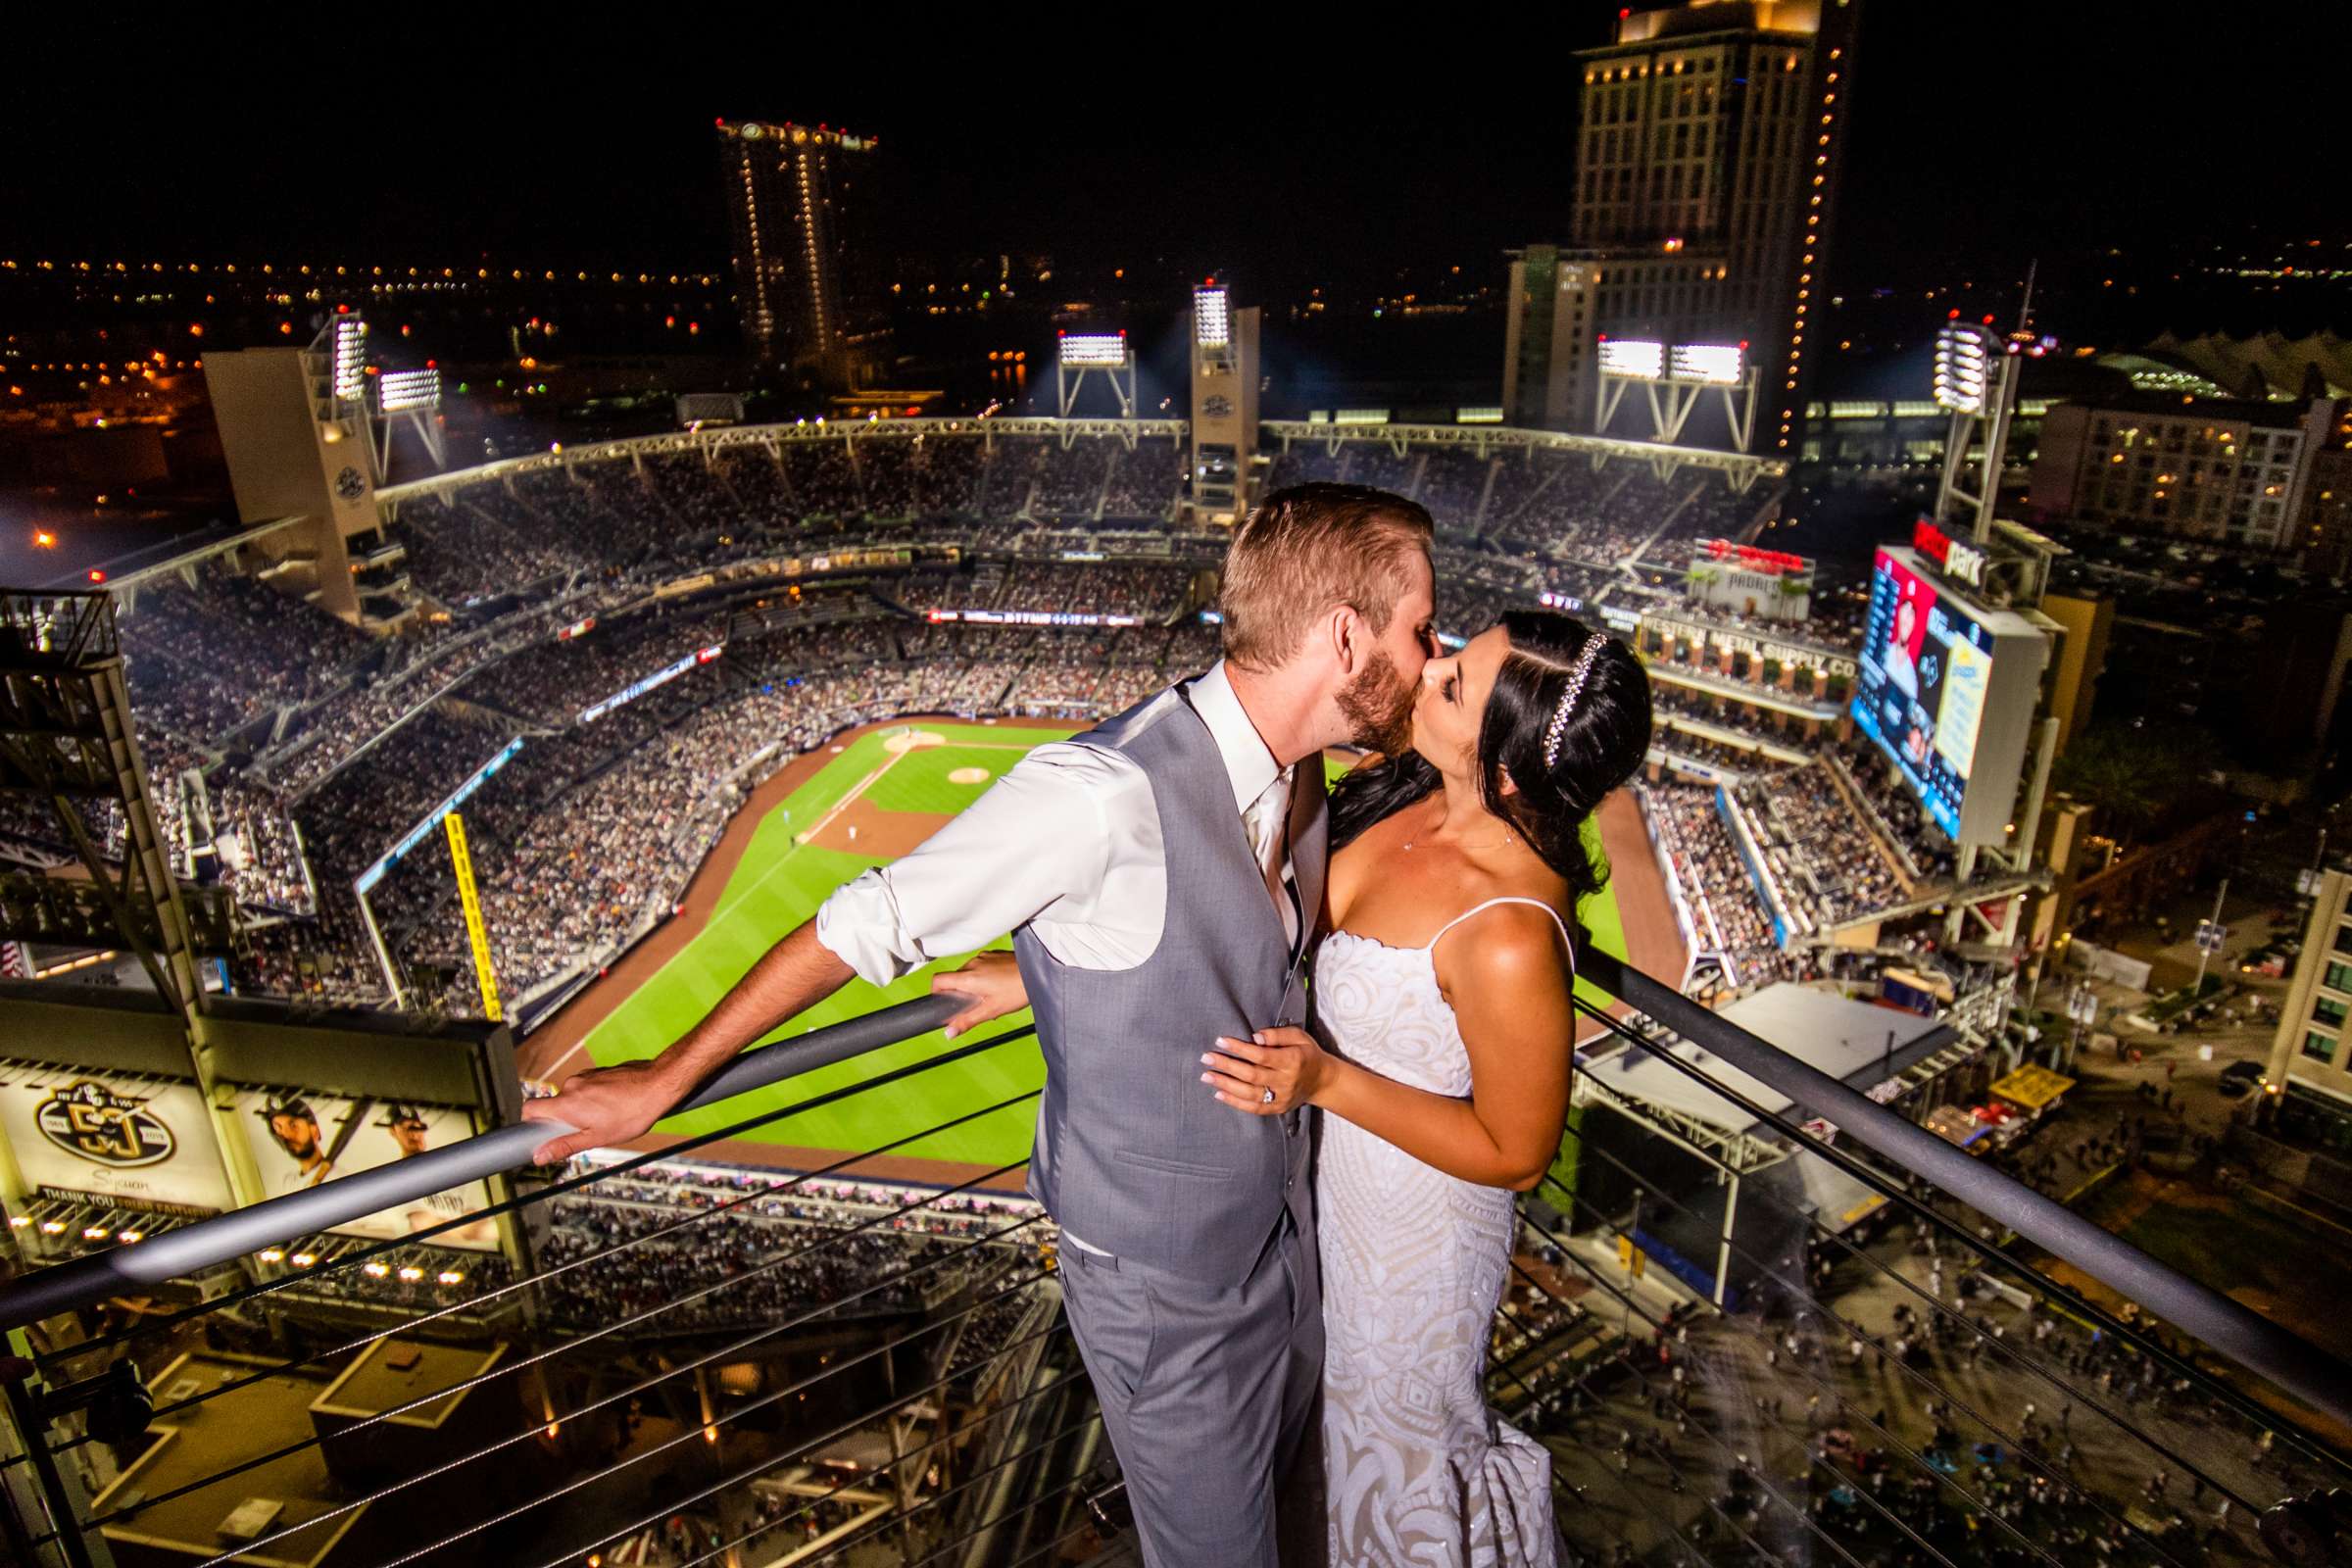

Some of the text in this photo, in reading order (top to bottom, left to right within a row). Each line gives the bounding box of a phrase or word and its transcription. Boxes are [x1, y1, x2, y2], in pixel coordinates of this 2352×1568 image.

[1944, 541, 1985, 587] park
[1729, 572, 1782, 594] PADRES
[1643, 615, 1706, 643] WESTERN
[1710, 631, 1757, 656] METAL
[1764, 644, 1825, 670] SUPPLY
[42, 1187, 86, 1204] THANK
[88, 1194, 115, 1208] YOU
